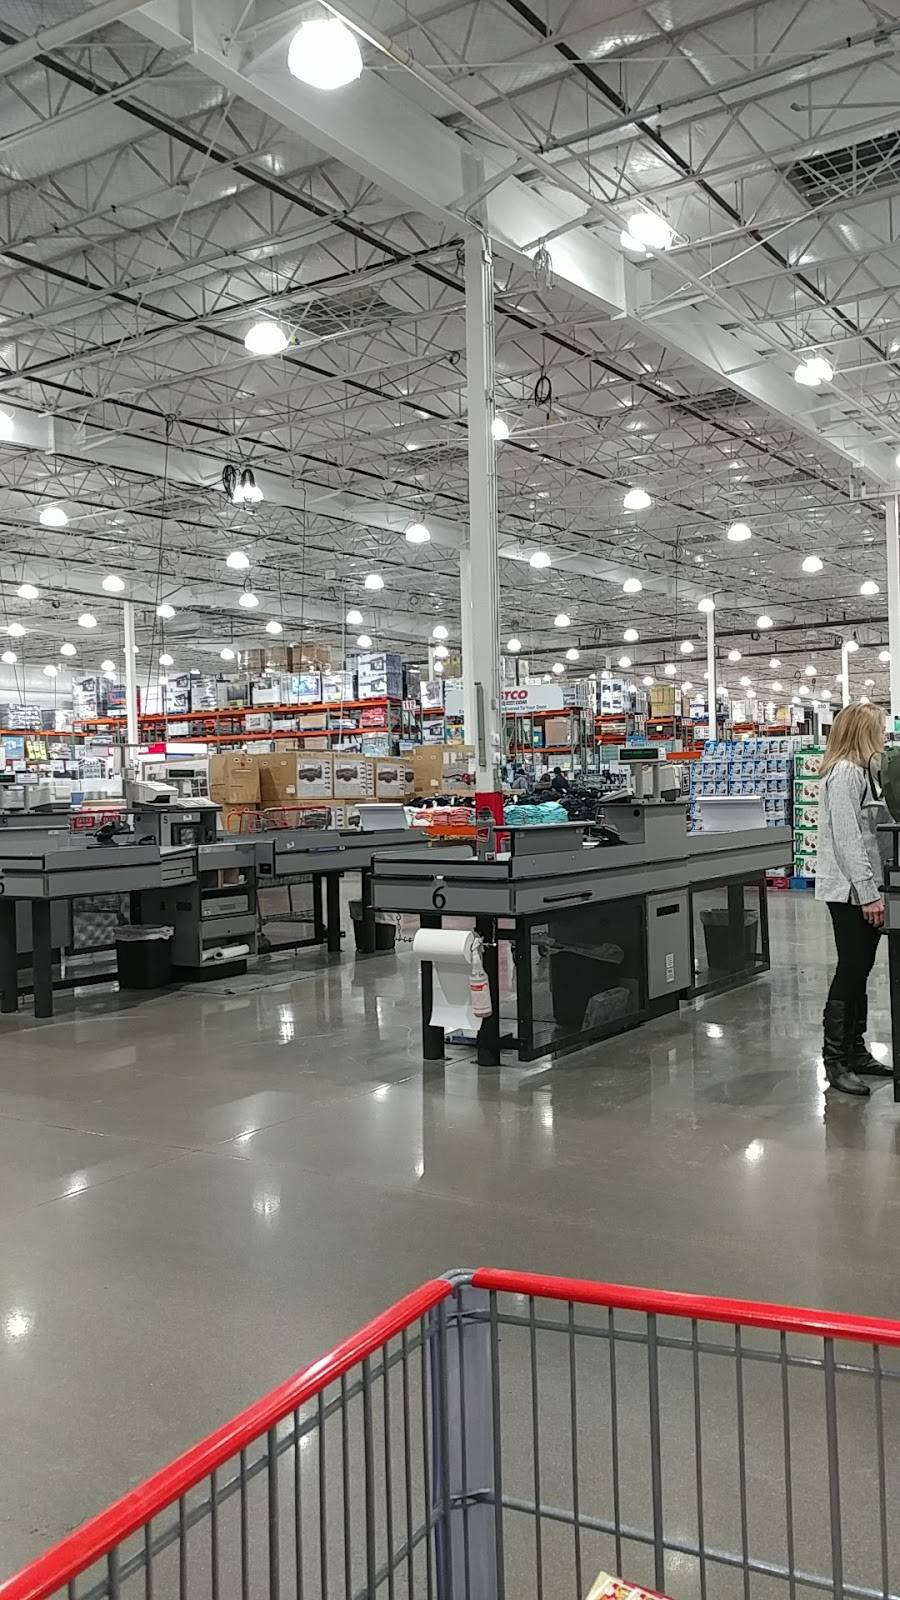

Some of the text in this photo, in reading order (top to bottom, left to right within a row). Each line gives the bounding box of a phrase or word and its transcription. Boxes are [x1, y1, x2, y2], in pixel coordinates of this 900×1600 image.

[404, 701, 415, 710] 112
[163, 815, 169, 824] 5
[432, 886, 446, 909] 6
